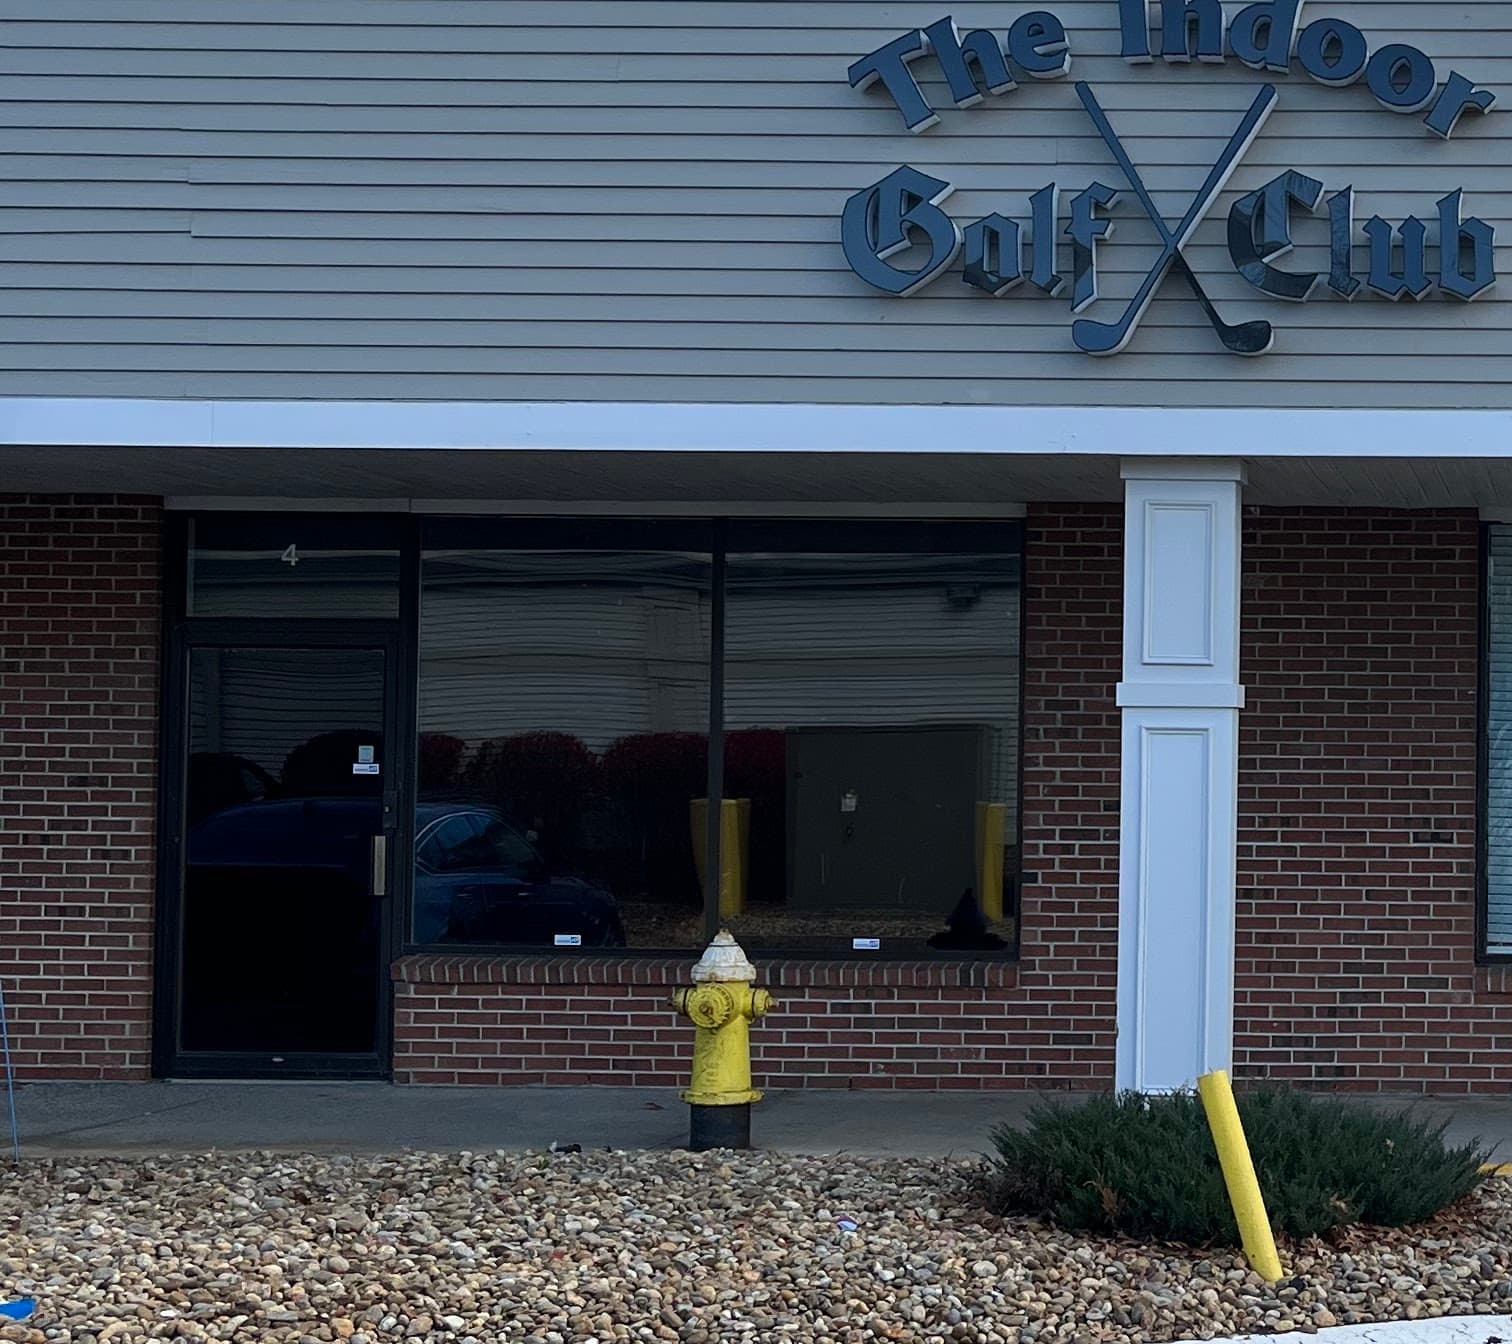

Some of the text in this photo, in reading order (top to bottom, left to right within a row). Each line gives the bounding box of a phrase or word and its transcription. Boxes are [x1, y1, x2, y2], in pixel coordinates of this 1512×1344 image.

[847, 11, 1072, 133] The
[841, 164, 1497, 313] Golf Club
[281, 543, 299, 566] 4
